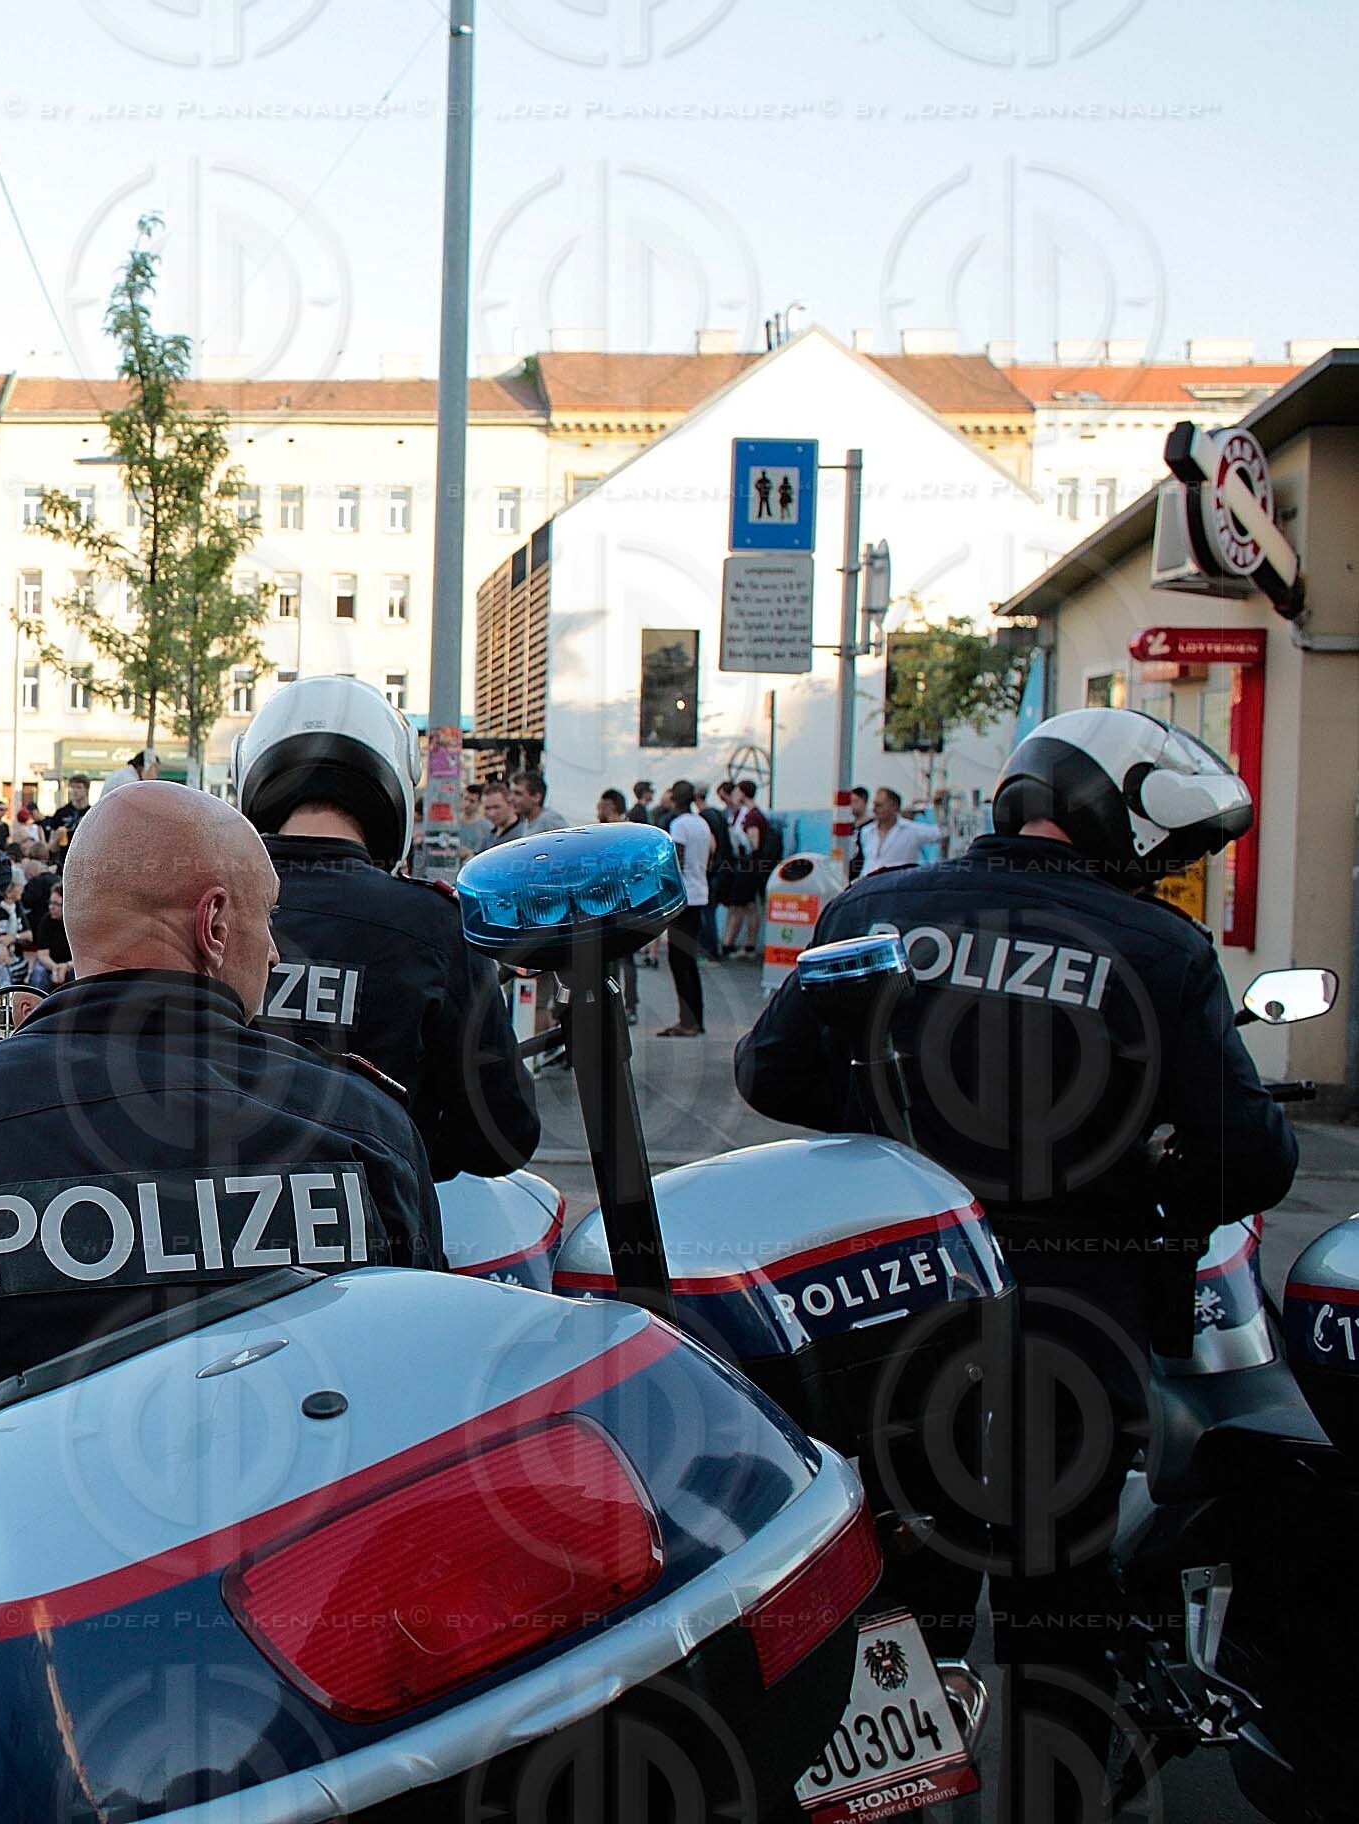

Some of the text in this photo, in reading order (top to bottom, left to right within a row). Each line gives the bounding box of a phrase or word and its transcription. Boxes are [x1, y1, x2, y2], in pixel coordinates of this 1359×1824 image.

[773, 1246, 958, 1325] POLIZEI
[845, 1778, 937, 1815] HONDA
[858, 1805, 896, 1823] Power
[898, 1799, 912, 1813] of
[913, 1786, 959, 1807] Dreams
